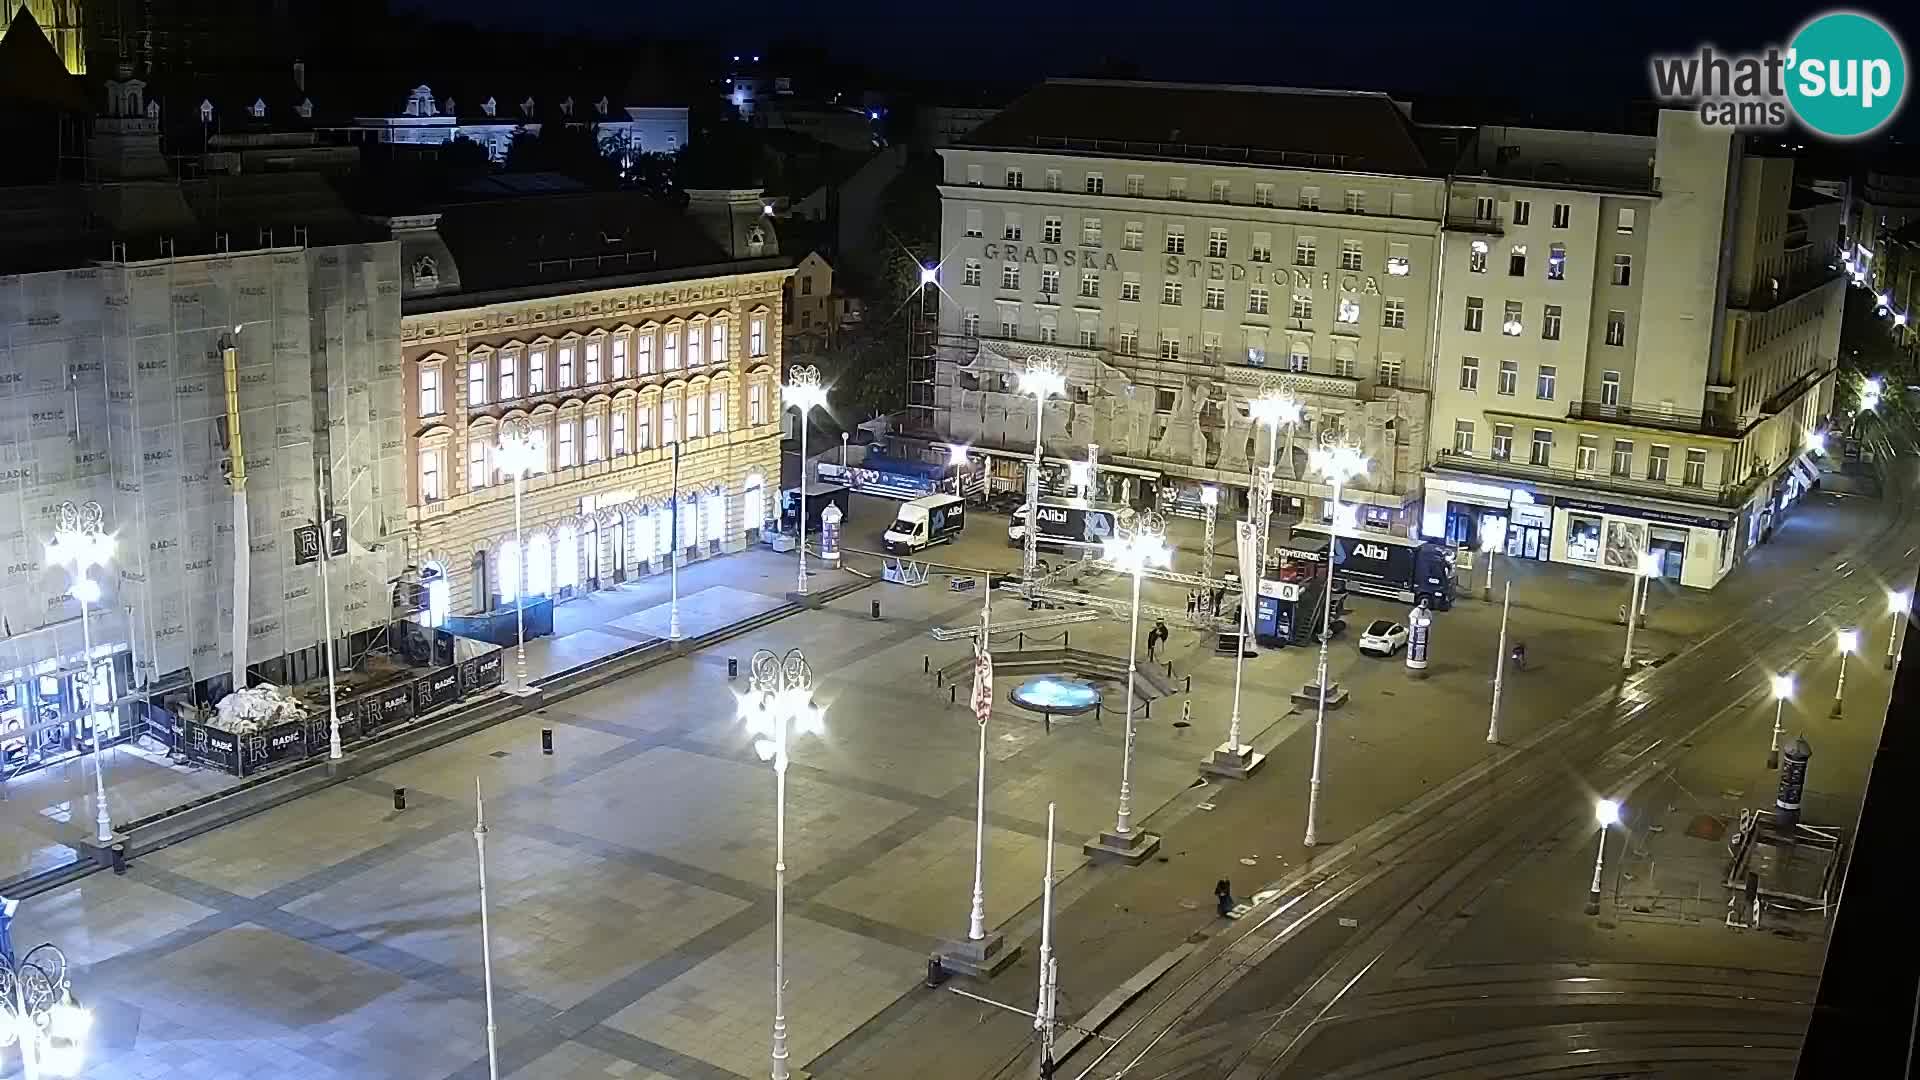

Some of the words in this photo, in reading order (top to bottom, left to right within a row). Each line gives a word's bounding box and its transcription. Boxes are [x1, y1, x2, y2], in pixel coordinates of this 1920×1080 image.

[984, 243, 1119, 272] GRADSKA
[1036, 509, 1067, 522] Alibi
[1352, 543, 1389, 561] Alibi
